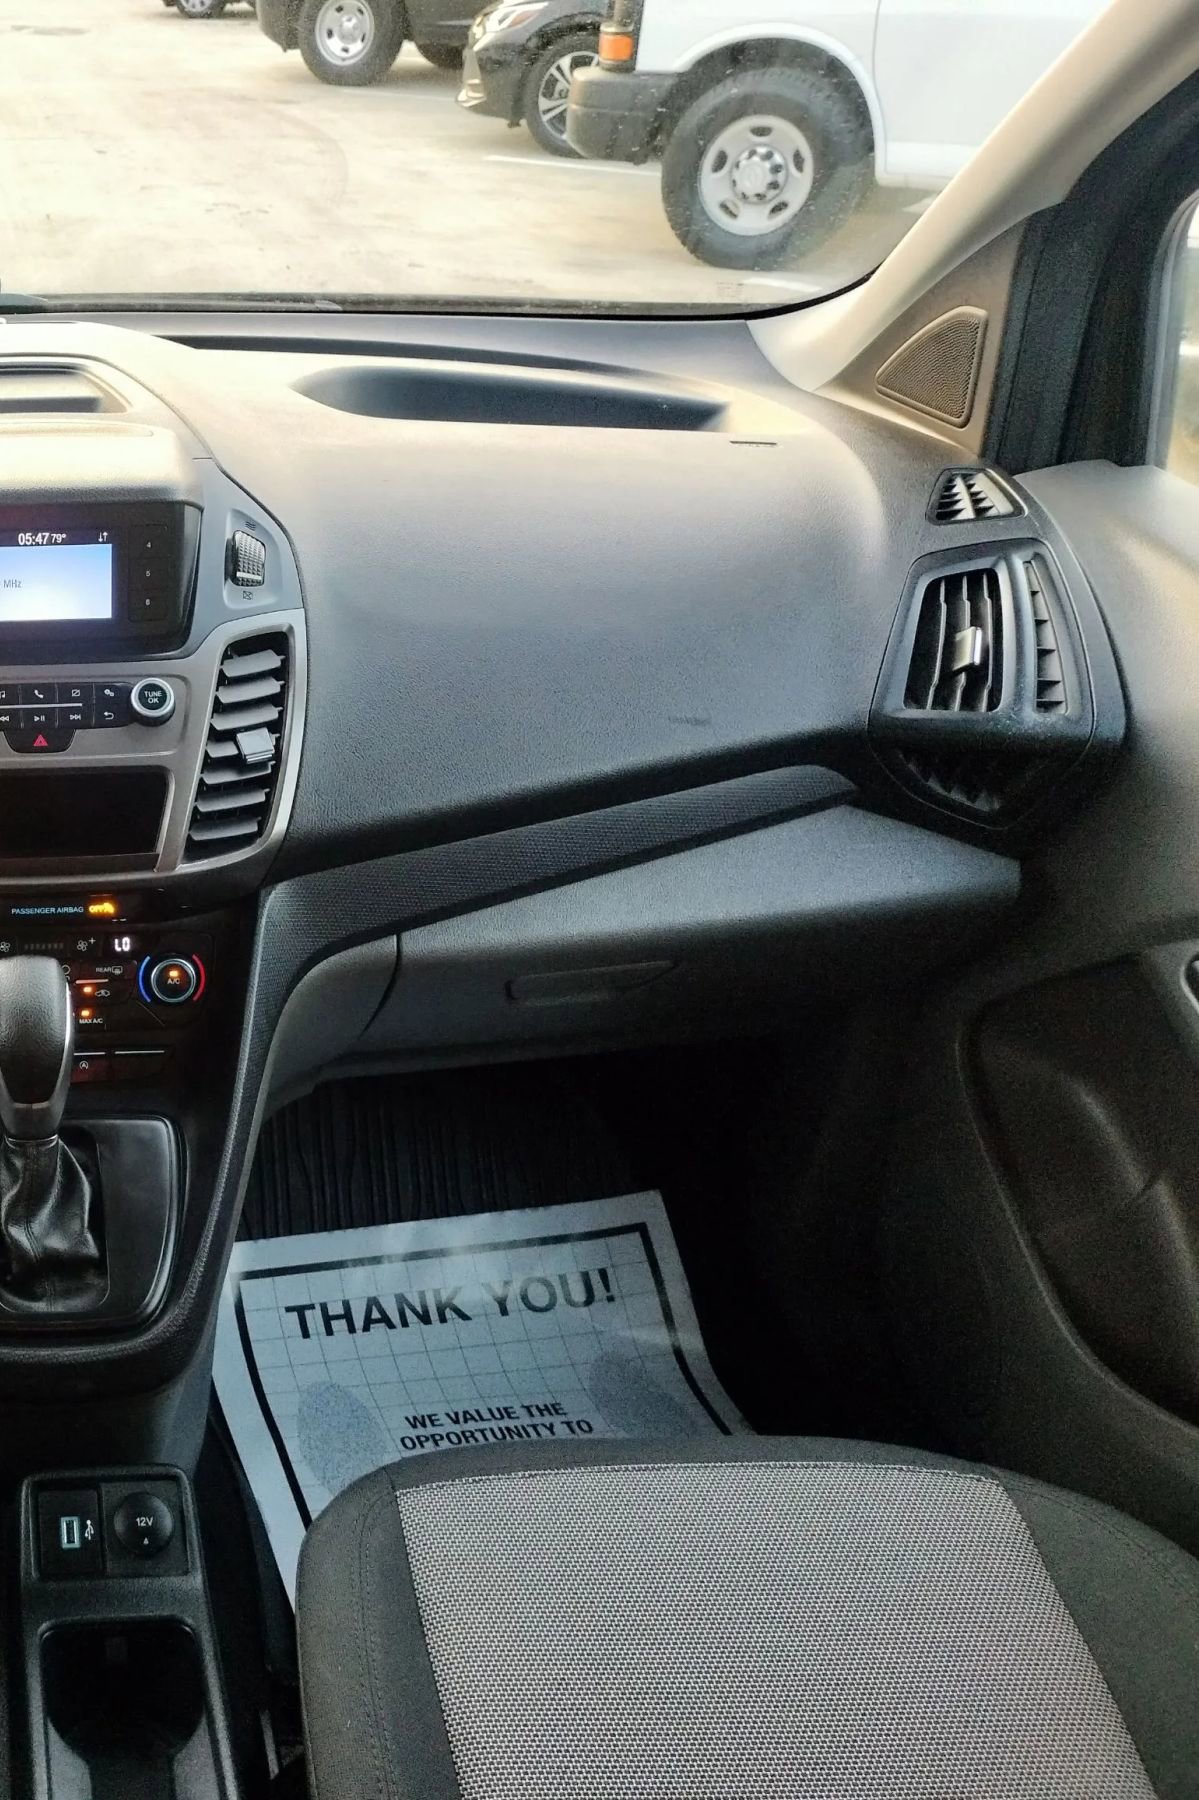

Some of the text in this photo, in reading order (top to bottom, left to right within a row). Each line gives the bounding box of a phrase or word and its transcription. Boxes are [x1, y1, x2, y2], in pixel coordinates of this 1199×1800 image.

[18, 532, 49, 545] 05:47
[3, 579, 22, 588] MHz
[11, 907, 56, 915] PASSENGER
[285, 1267, 616, 1339] THANK YOU!
[405, 1402, 568, 1429] WE VALUE THE
[400, 1419, 594, 1451] OPPORTUNITY TO
[136, 1517, 153, 1527] 12V
